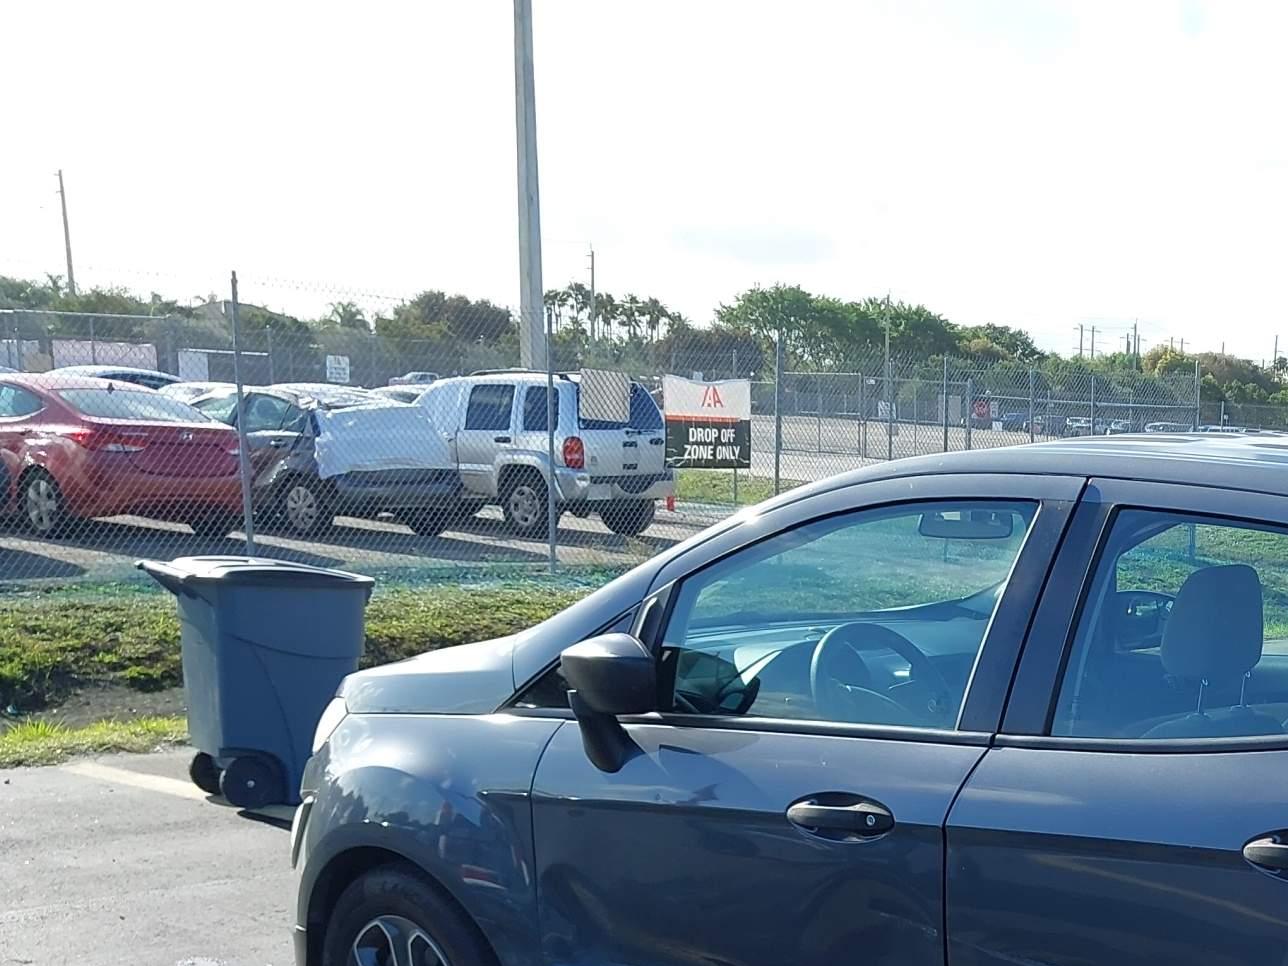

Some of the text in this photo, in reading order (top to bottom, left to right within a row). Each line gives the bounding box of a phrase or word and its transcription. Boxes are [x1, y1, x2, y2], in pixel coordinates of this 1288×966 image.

[688, 427, 735, 443] DROP OFF
[683, 445, 740, 460] ZONE ONLY
